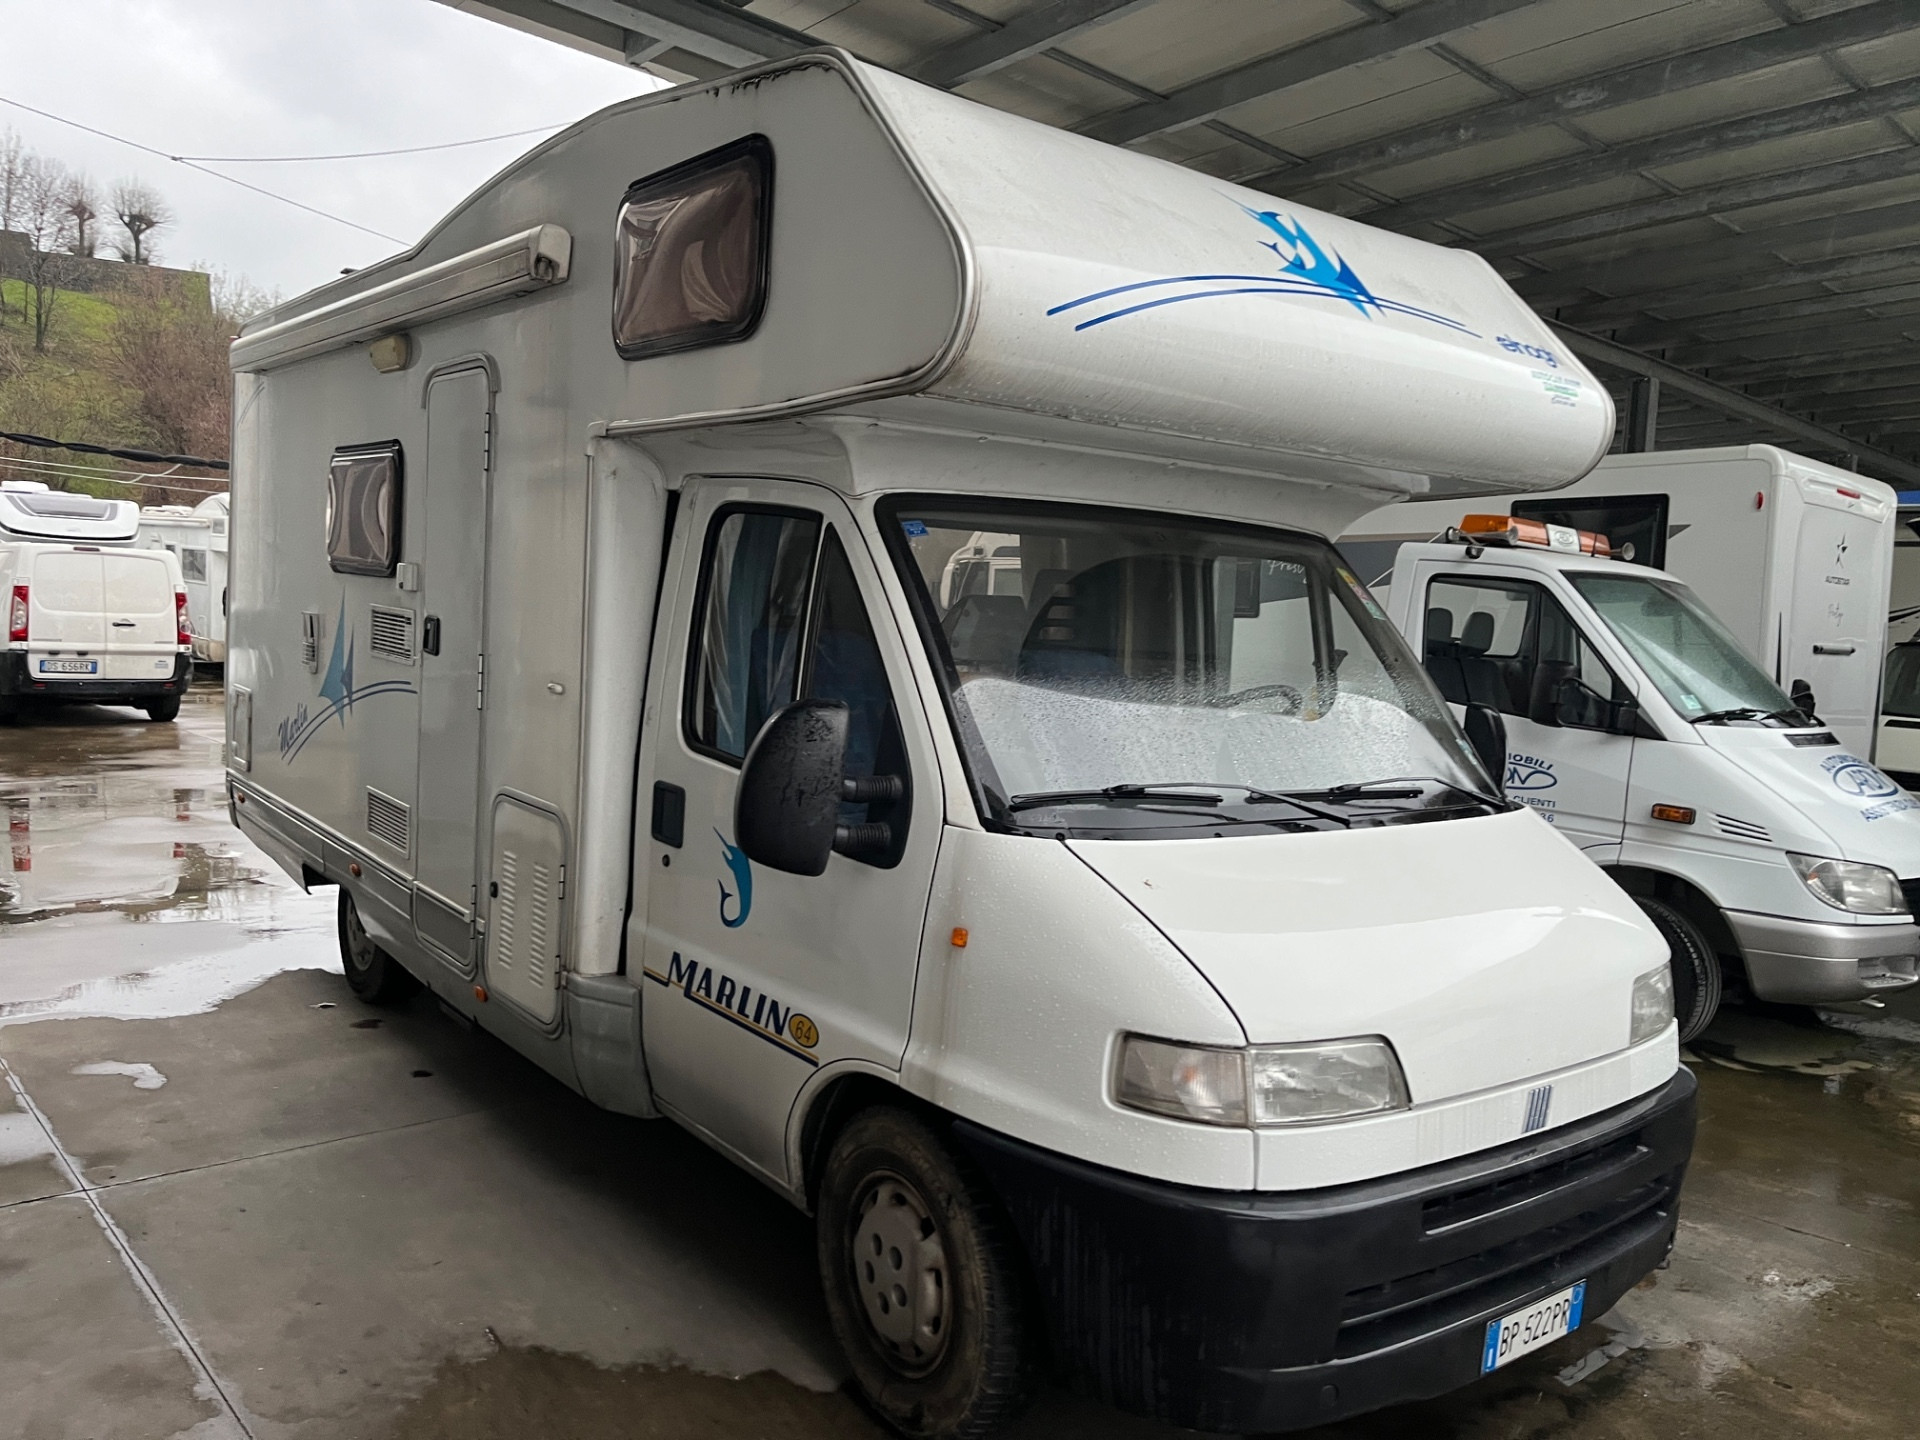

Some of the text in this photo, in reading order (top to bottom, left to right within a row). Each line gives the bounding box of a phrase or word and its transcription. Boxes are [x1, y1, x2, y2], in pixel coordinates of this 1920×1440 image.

[668, 951, 813, 1043] MARLIN 64
[1499, 1298, 1571, 1358] BP 522PR
